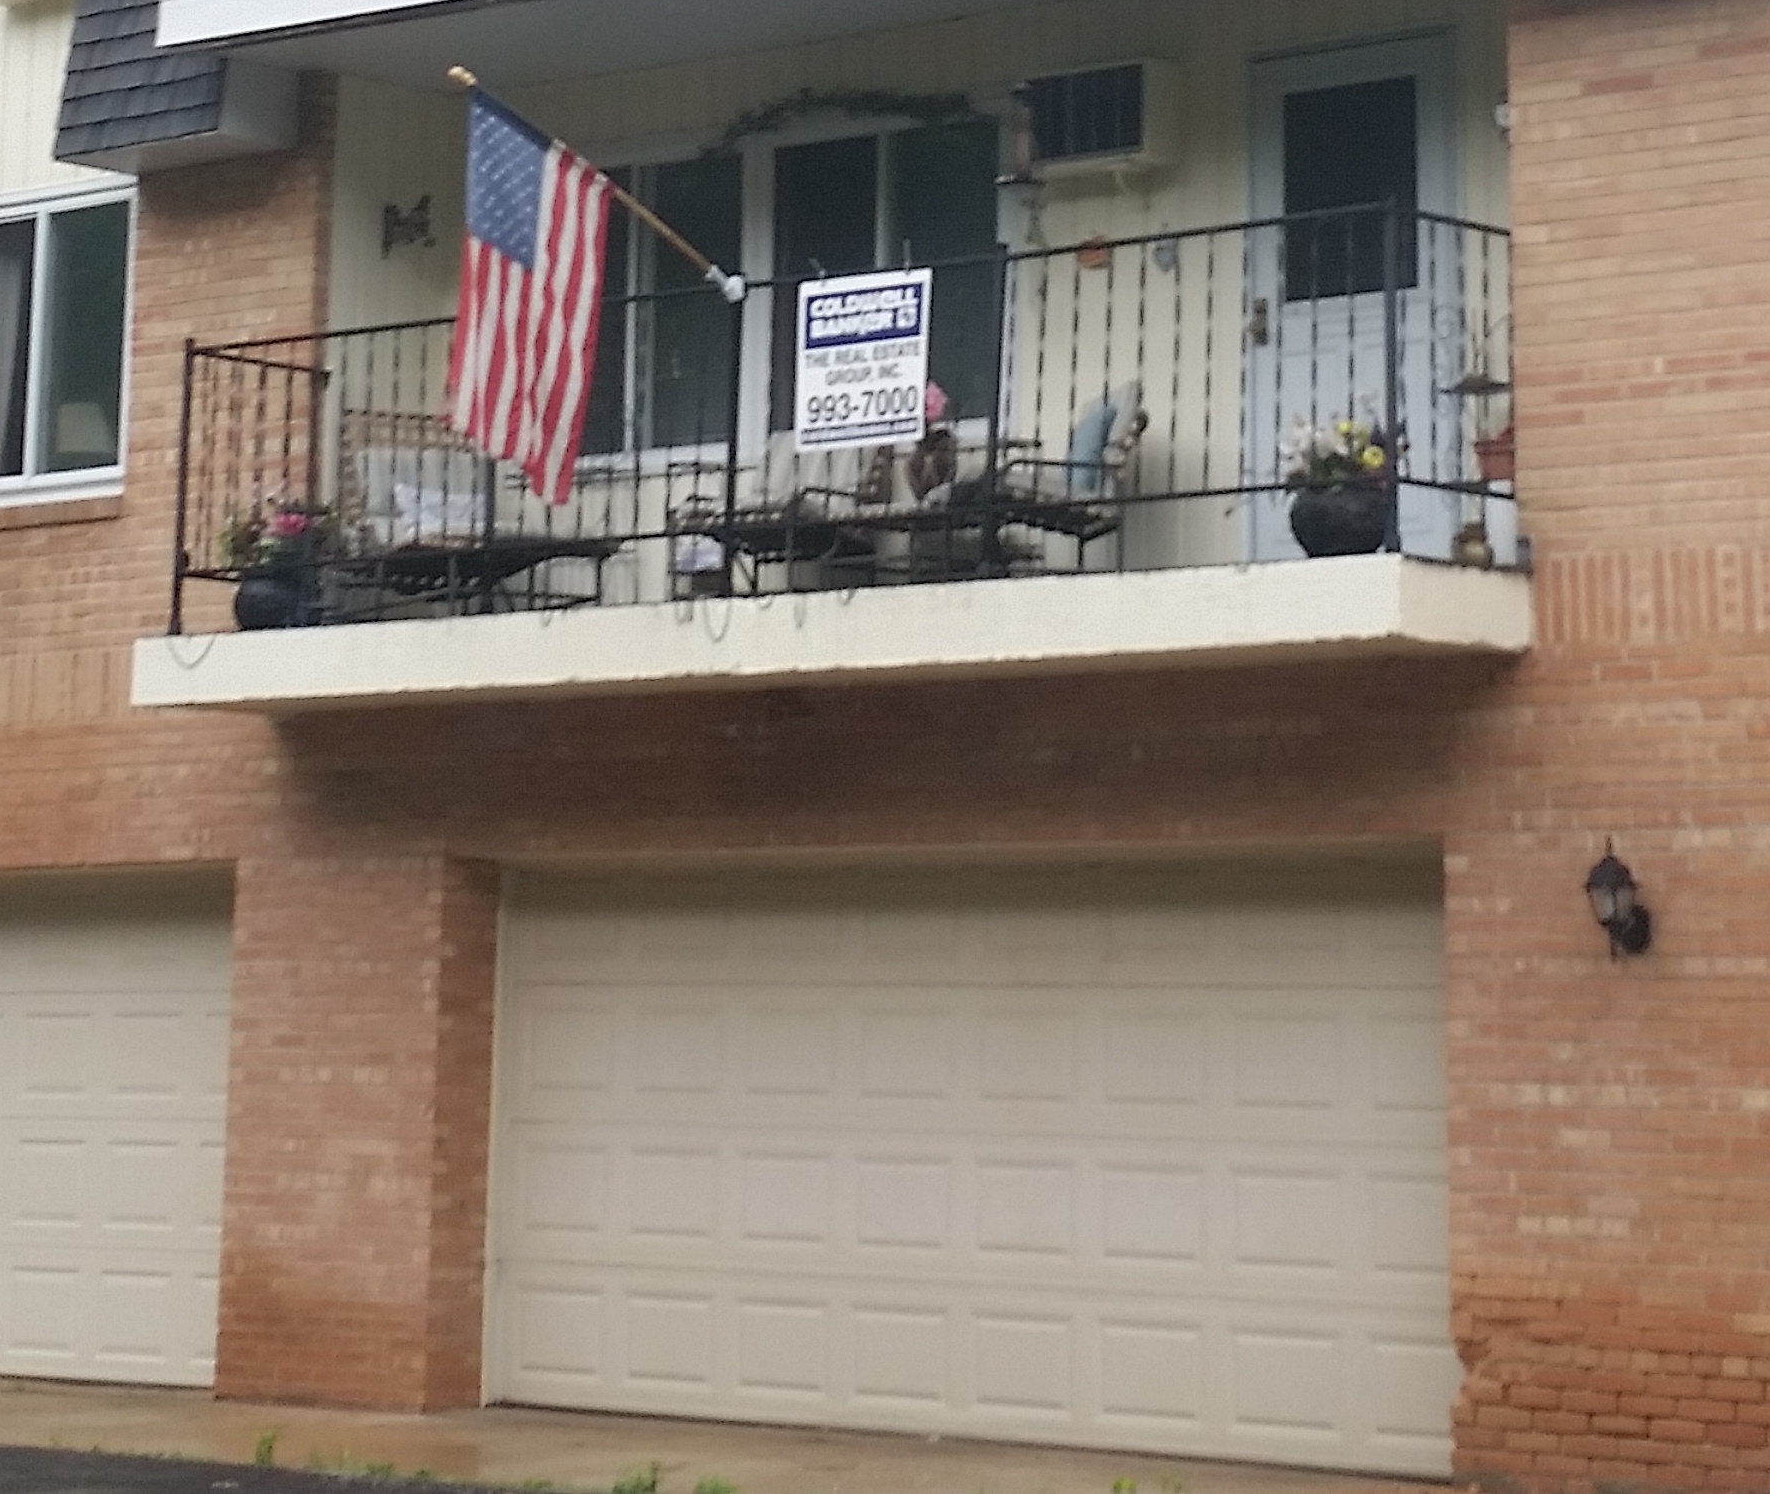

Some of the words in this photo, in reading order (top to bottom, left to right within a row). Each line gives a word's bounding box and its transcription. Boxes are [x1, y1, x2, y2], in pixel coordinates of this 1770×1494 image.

[833, 345, 867, 365] REAL
[872, 341, 919, 362] ESTATE
[807, 385, 919, 423] 993-7000
